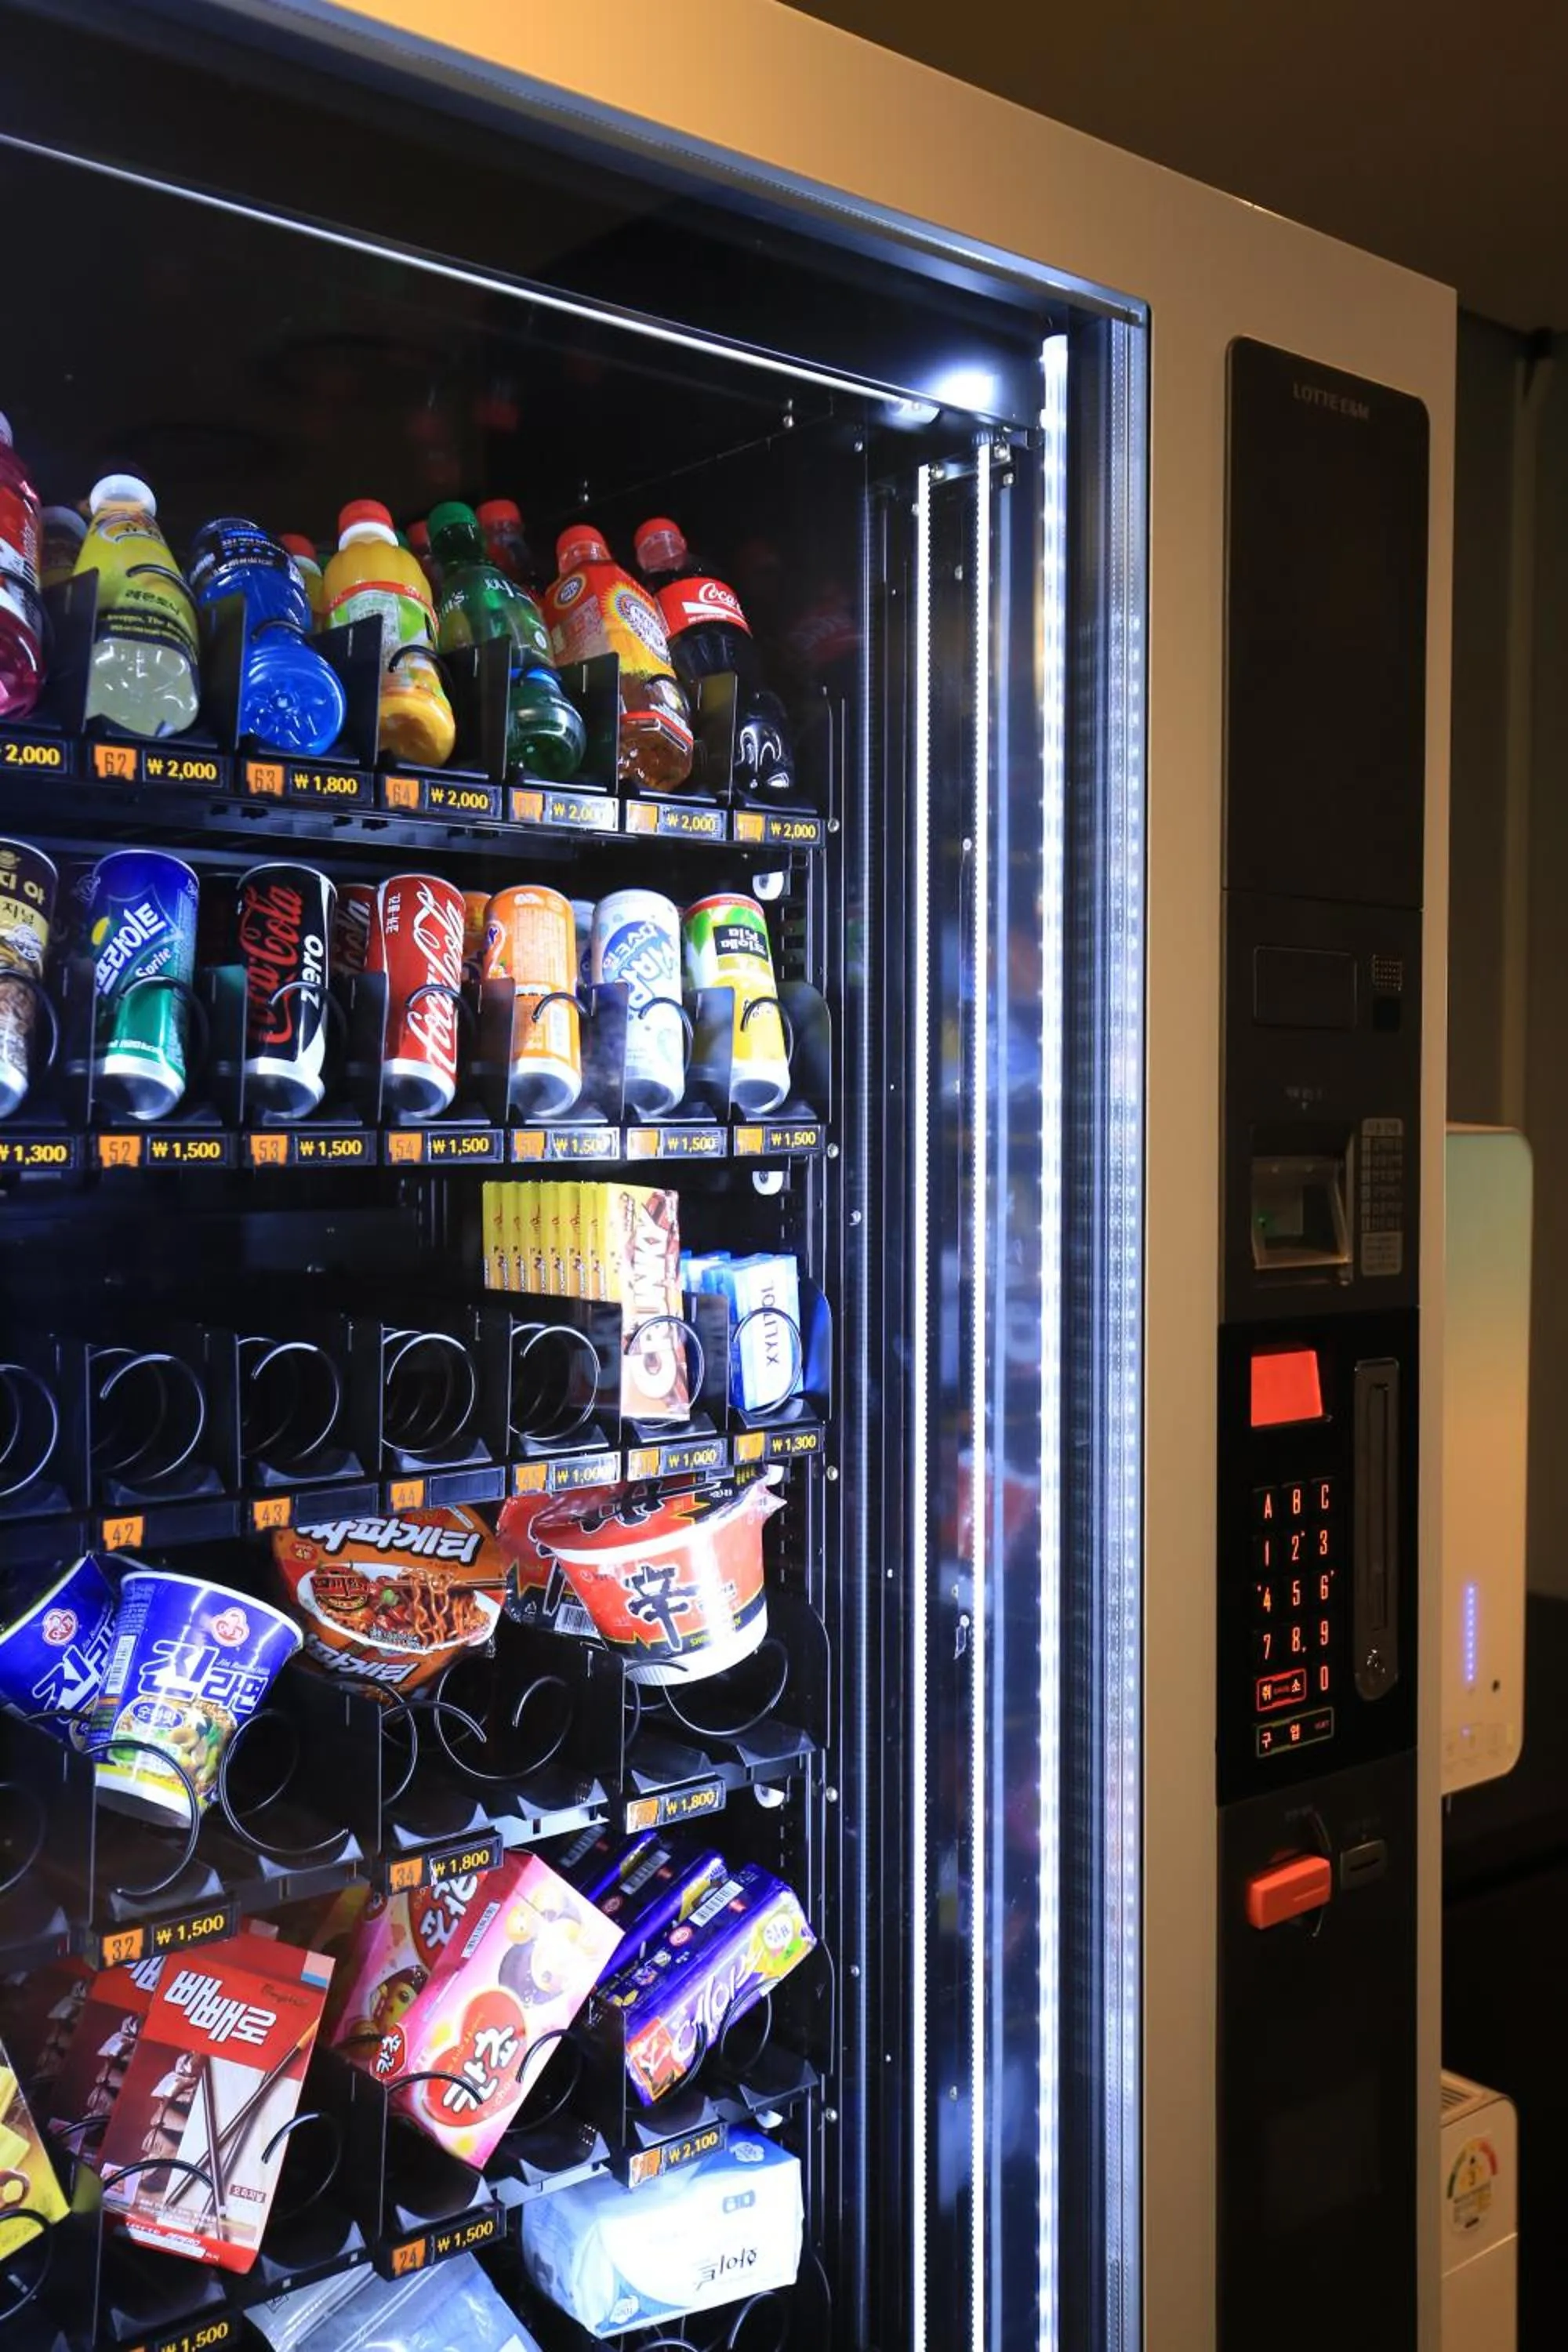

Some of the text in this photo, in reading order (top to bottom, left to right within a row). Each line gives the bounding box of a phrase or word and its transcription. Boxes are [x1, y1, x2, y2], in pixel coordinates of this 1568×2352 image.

[5, 745, 60, 766] 2,000
[105, 753, 127, 774] 62
[168, 759, 216, 780] 2,000
[255, 769, 276, 791] 63
[314, 775, 358, 794] 1,800
[448, 791, 488, 810] 2,000
[784, 824, 815, 839] 2,000
[95, 903, 167, 996] 프라이트
[135, 948, 171, 977] Sprite
[301, 934, 324, 1010] zero
[172, 1142, 220, 1161] 1,500
[259, 1139, 279, 1160] 53
[318, 1139, 363, 1159] 1,500
[449, 1138, 489, 1156] 1,500
[785, 1131, 816, 1148] 1,500
[13, 1145, 67, 1165] 1,300
[108, 1141, 131, 1163] 52
[760, 1280, 780, 1368] XYLITOL
[784, 1435, 816, 1453] 1,300
[1264, 1484, 1329, 1519] A B C
[262, 1503, 284, 1525] 43
[112, 1522, 134, 1546] 42
[1265, 1530, 1327, 1566] 1 2 3
[1263, 1575, 1329, 1613] 4 5 6
[626, 1565, 699, 1651] 辛
[1263, 1621, 1329, 1660] 7 8 9
[1320, 1666, 1329, 1691] 0
[450, 1849, 489, 1874] 1,800
[178, 1914, 224, 1941] 1,500
[112, 1936, 134, 1961] 32
[164, 1969, 277, 2045] 빼빼로
[683, 2132, 718, 2158] 2,100
[454, 2220, 493, 2248] 1,500
[399, 2247, 417, 2271] 24
[181, 2322, 228, 2352] 1,500
